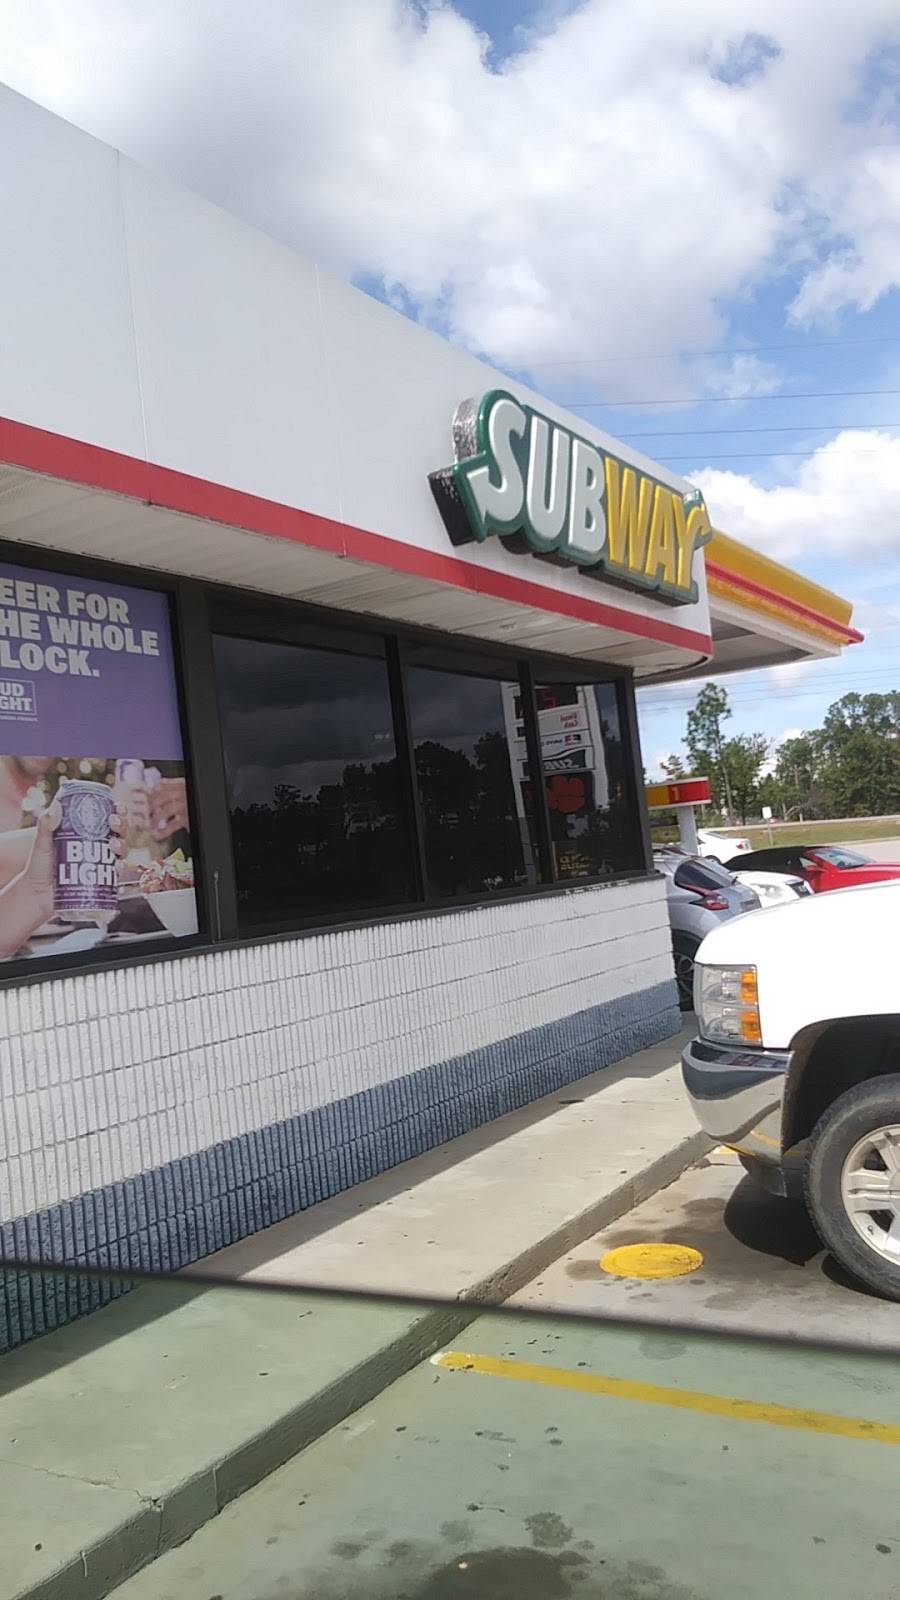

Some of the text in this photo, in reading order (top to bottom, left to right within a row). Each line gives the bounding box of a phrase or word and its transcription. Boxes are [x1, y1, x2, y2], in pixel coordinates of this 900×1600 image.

[467, 399, 711, 590] SUBWAY
[66, 589, 130, 625] FOR
[47, 615, 160, 657] WHOLE
[0, 640, 100, 678] LOCK.
[671, 786, 680, 801] 1
[66, 840, 116, 864] BUD
